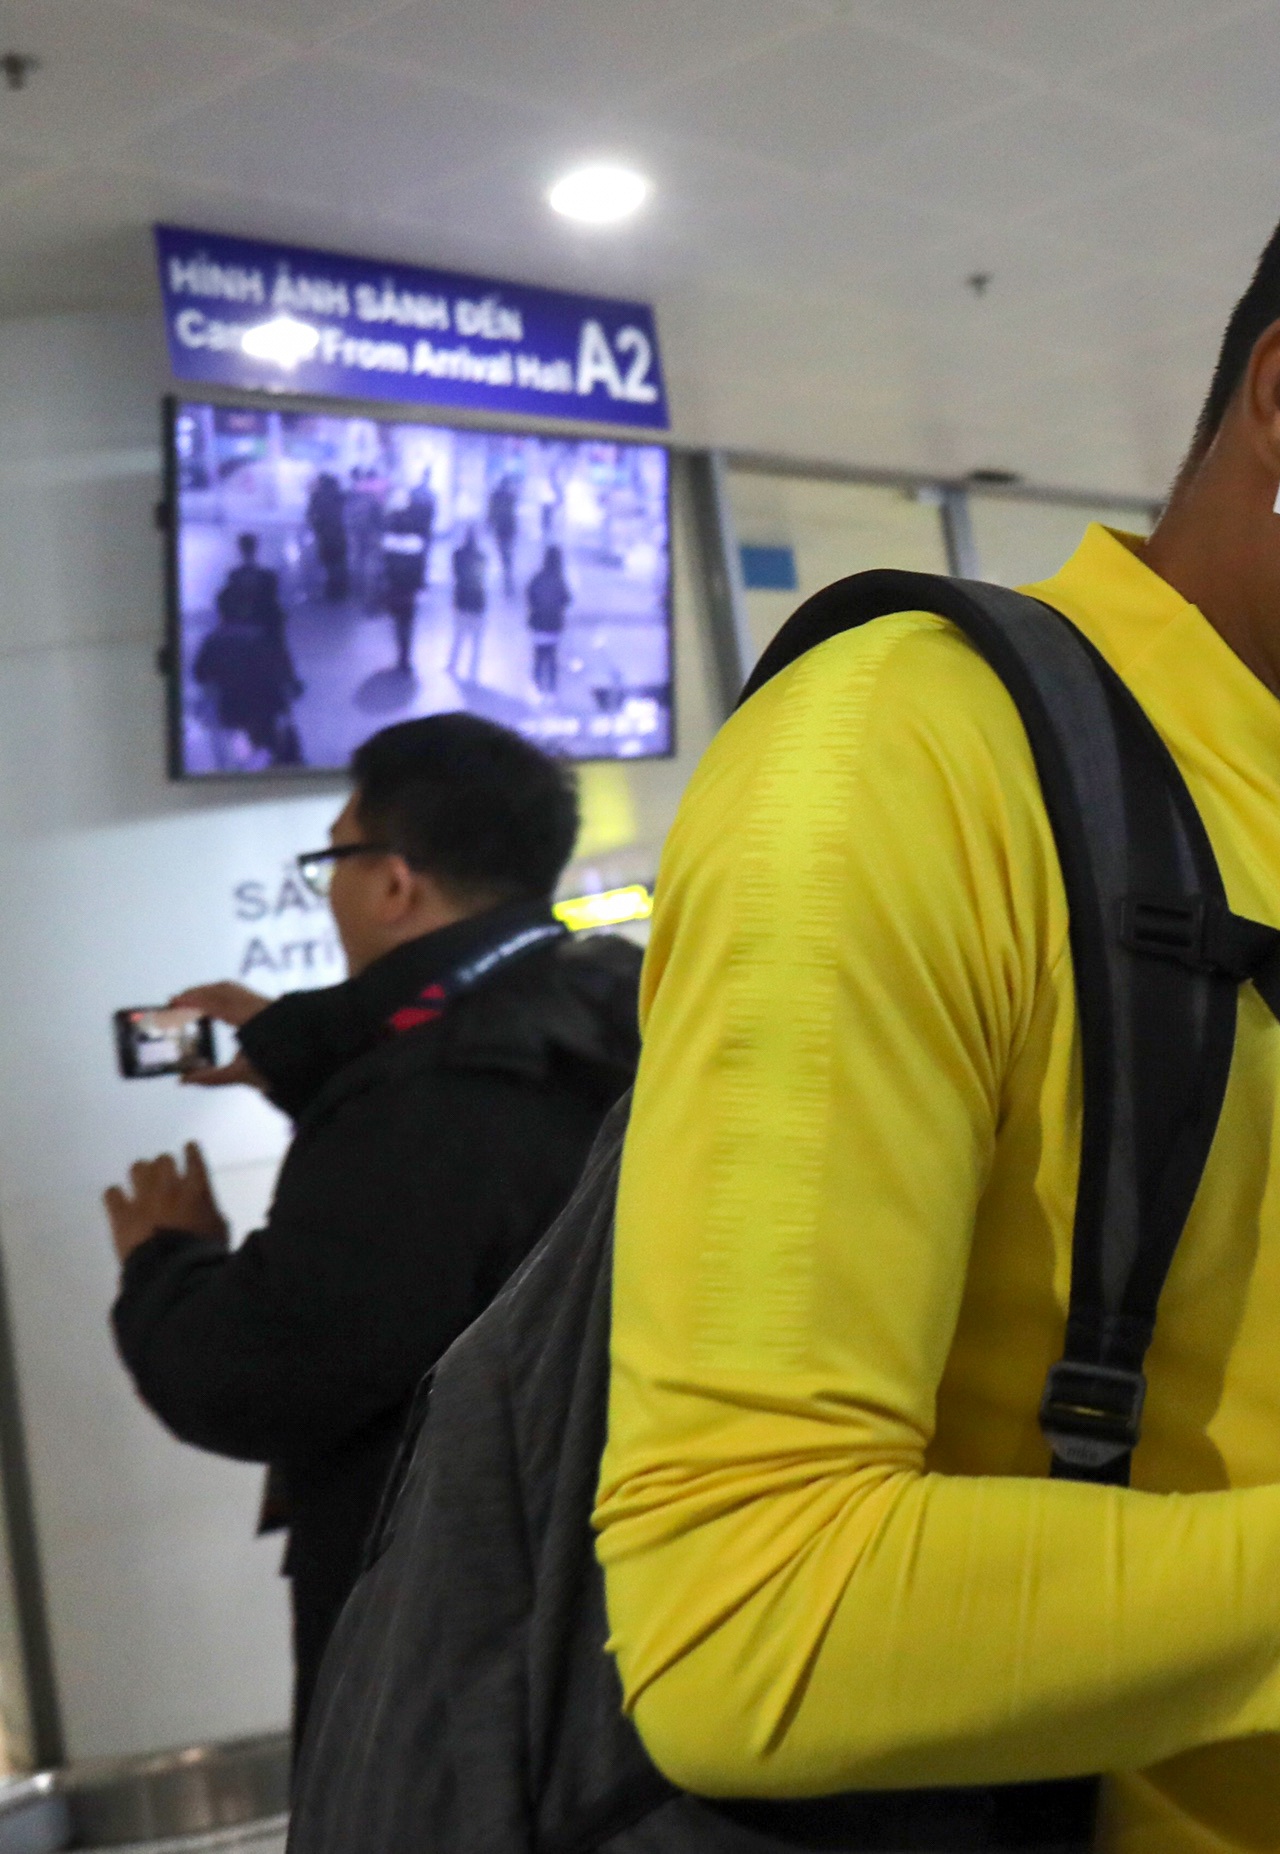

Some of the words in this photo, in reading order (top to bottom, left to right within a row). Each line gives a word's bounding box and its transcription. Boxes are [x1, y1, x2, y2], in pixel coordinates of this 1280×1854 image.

[322, 327, 409, 374] From
[412, 338, 513, 386] Arrival
[515, 353, 573, 394] Hall
[576, 318, 659, 404] A2
